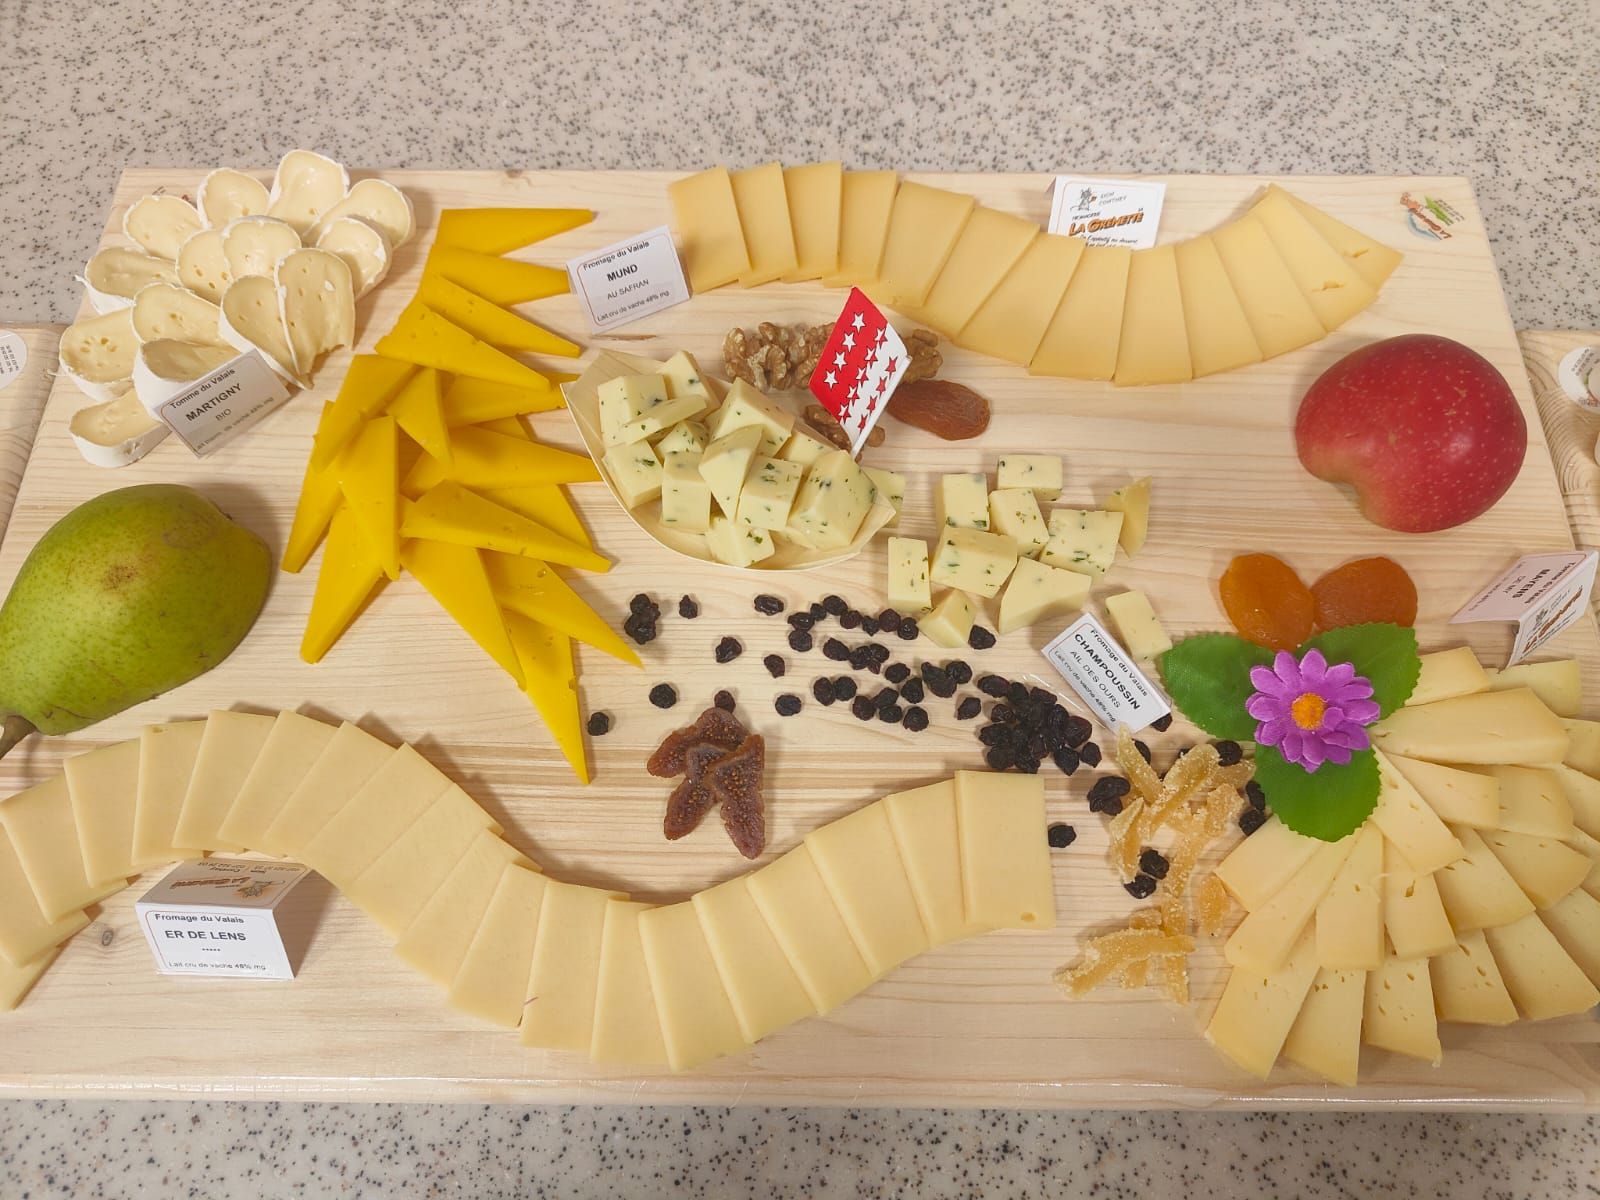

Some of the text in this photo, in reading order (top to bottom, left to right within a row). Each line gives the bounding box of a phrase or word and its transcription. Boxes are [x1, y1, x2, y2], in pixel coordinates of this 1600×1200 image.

[1068, 222, 1086, 236] LA
[583, 240, 650, 271] Fromage du Valais
[606, 263, 638, 282] MUND
[607, 278, 649, 300] AU SAFRAN
[619, 305, 627, 313] de
[170, 368, 236, 409] Tomme du Valais
[185, 383, 242, 421] MARTIGNY
[215, 408, 232, 421] BIO
[1512, 569, 1551, 598] MAYENS
[1074, 633, 1141, 710] CHAMPOUSSIN
[1090, 629, 1148, 697] Fromage du Valais
[1072, 672, 1081, 681] de
[1080, 680, 1096, 699] vache
[1106, 711, 1116, 722] mg
[1082, 664, 1100, 683] DES
[1098, 683, 1121, 708] OURS
[155, 913, 244, 924] Fromage du Valais
[164, 930, 247, 941] ER DE LENS
